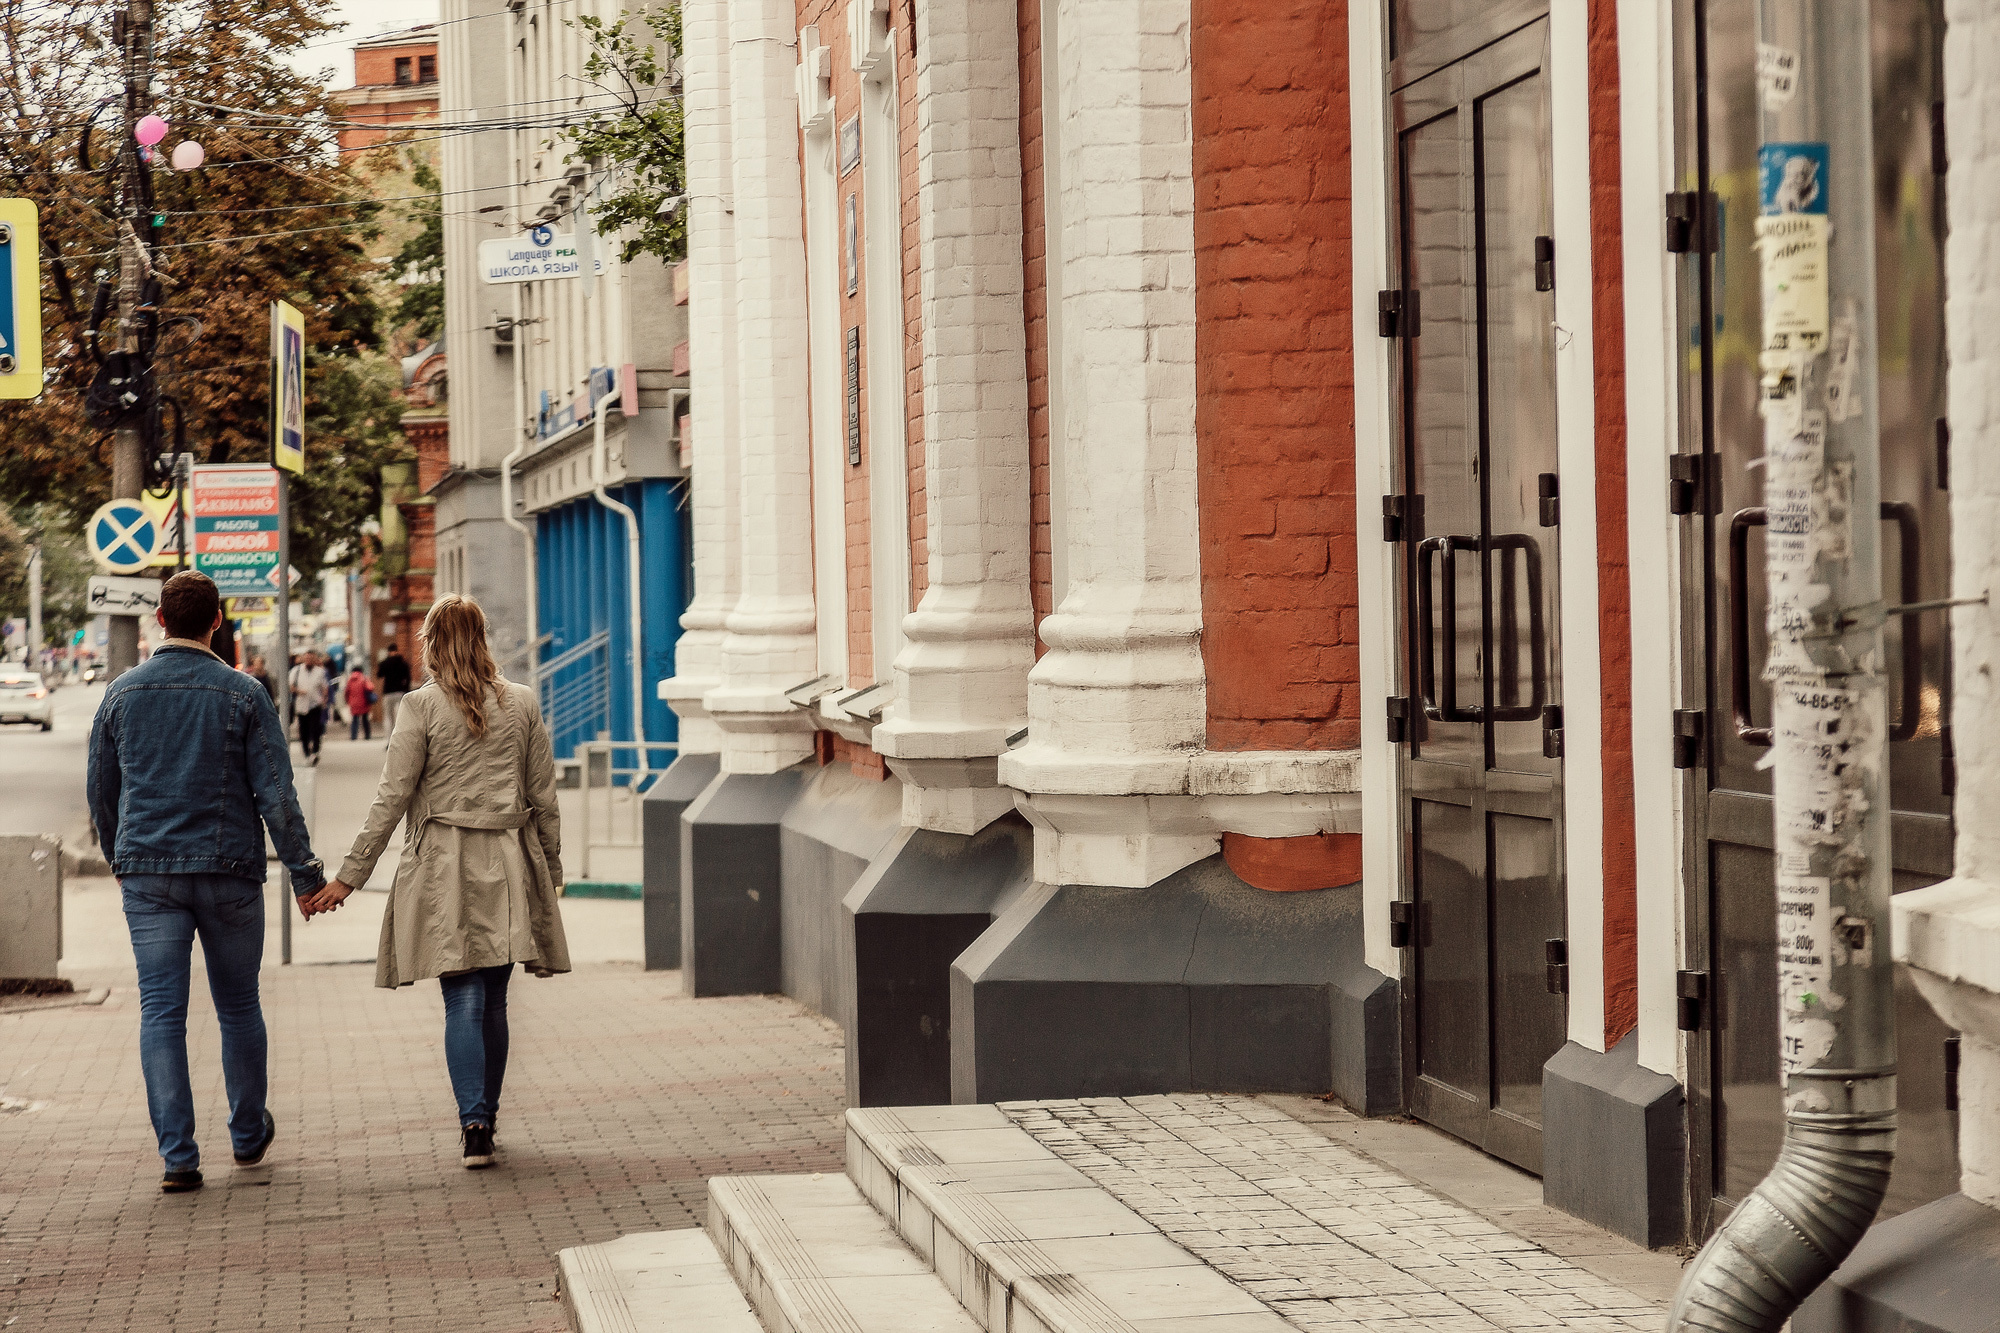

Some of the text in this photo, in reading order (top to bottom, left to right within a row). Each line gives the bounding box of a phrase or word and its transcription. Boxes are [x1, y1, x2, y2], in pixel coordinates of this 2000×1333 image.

[508, 249, 553, 262] Language
[489, 260, 602, 278] ШКОЛА ЯЗЫВ
[214, 520, 259, 530] РАБОТЫ
[206, 531, 270, 551] ЛЮБОЙ
[200, 552, 277, 567] СЛОЖНОСТИ
